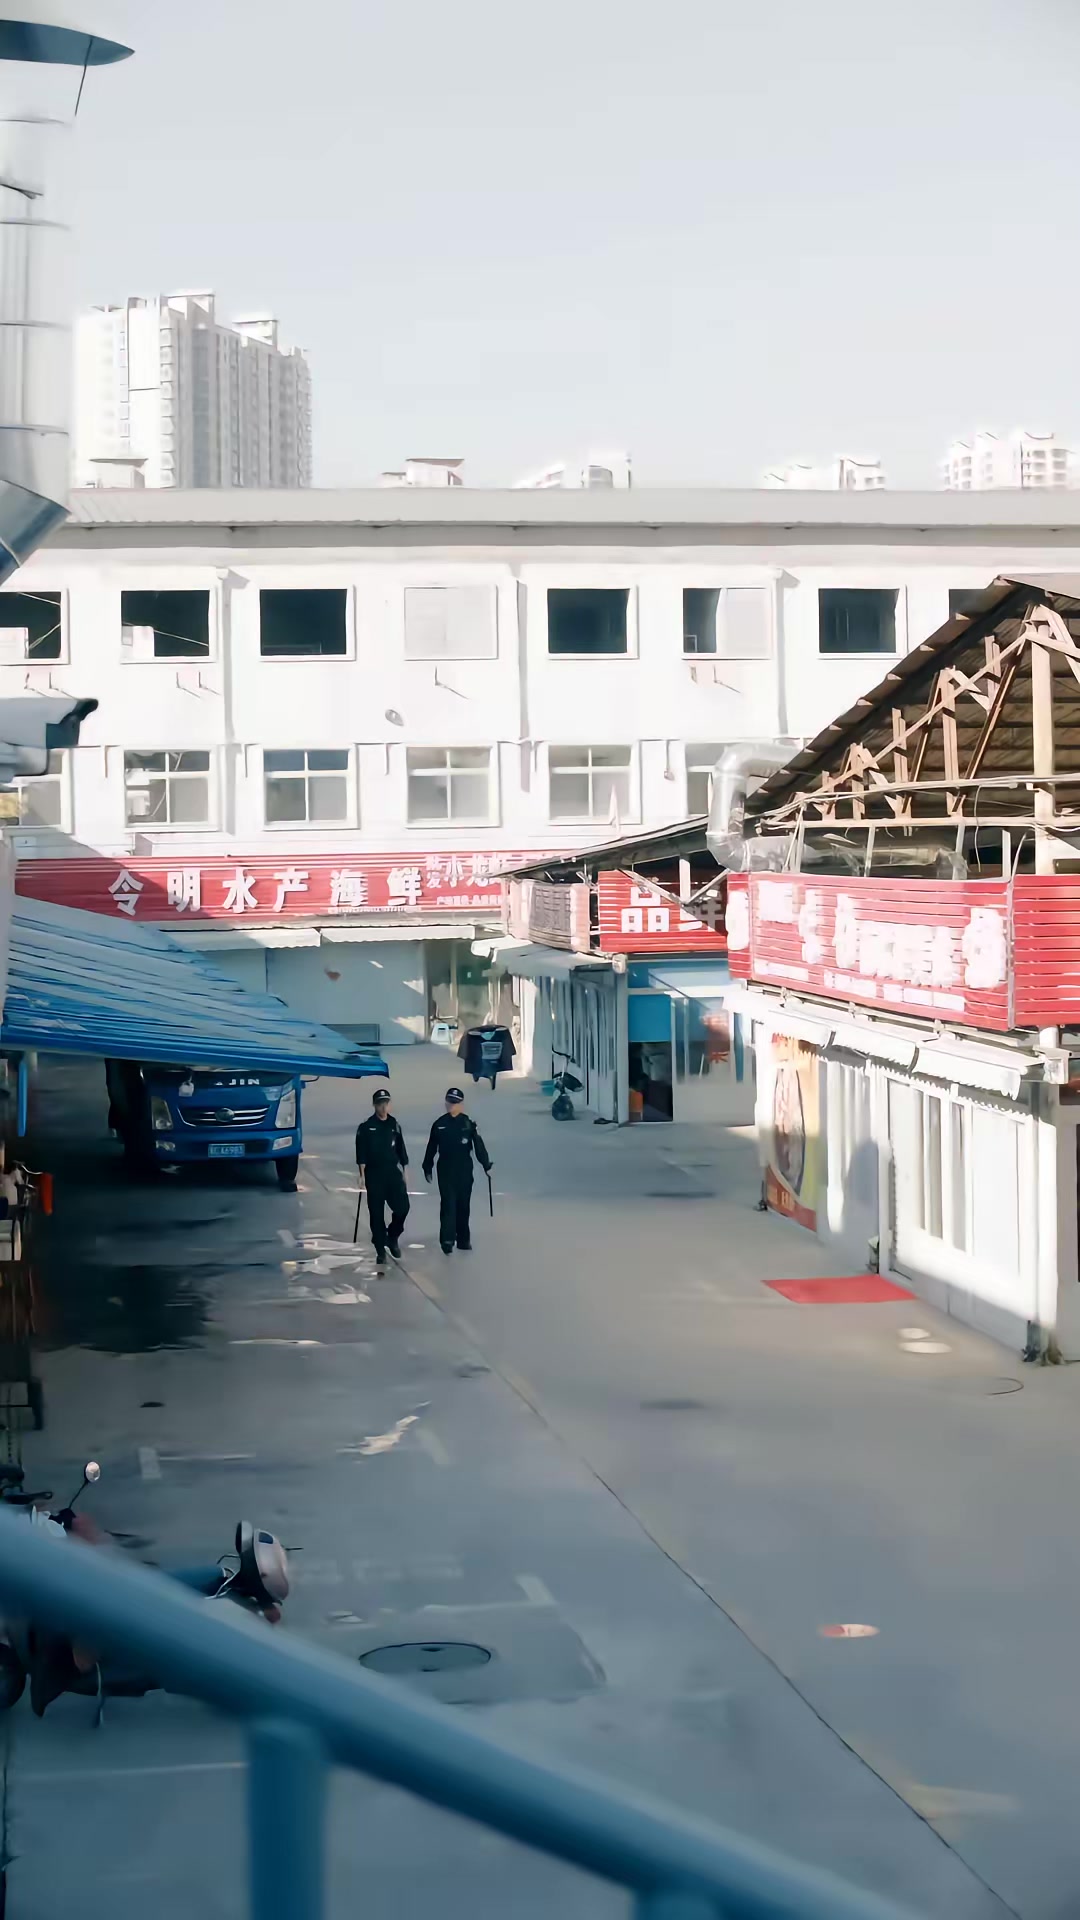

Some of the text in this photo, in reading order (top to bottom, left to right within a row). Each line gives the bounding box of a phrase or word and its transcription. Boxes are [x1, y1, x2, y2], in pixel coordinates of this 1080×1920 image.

[107, 866, 423, 916] 令明水产海鲜
[215, 1078, 260, 1086] JIN
